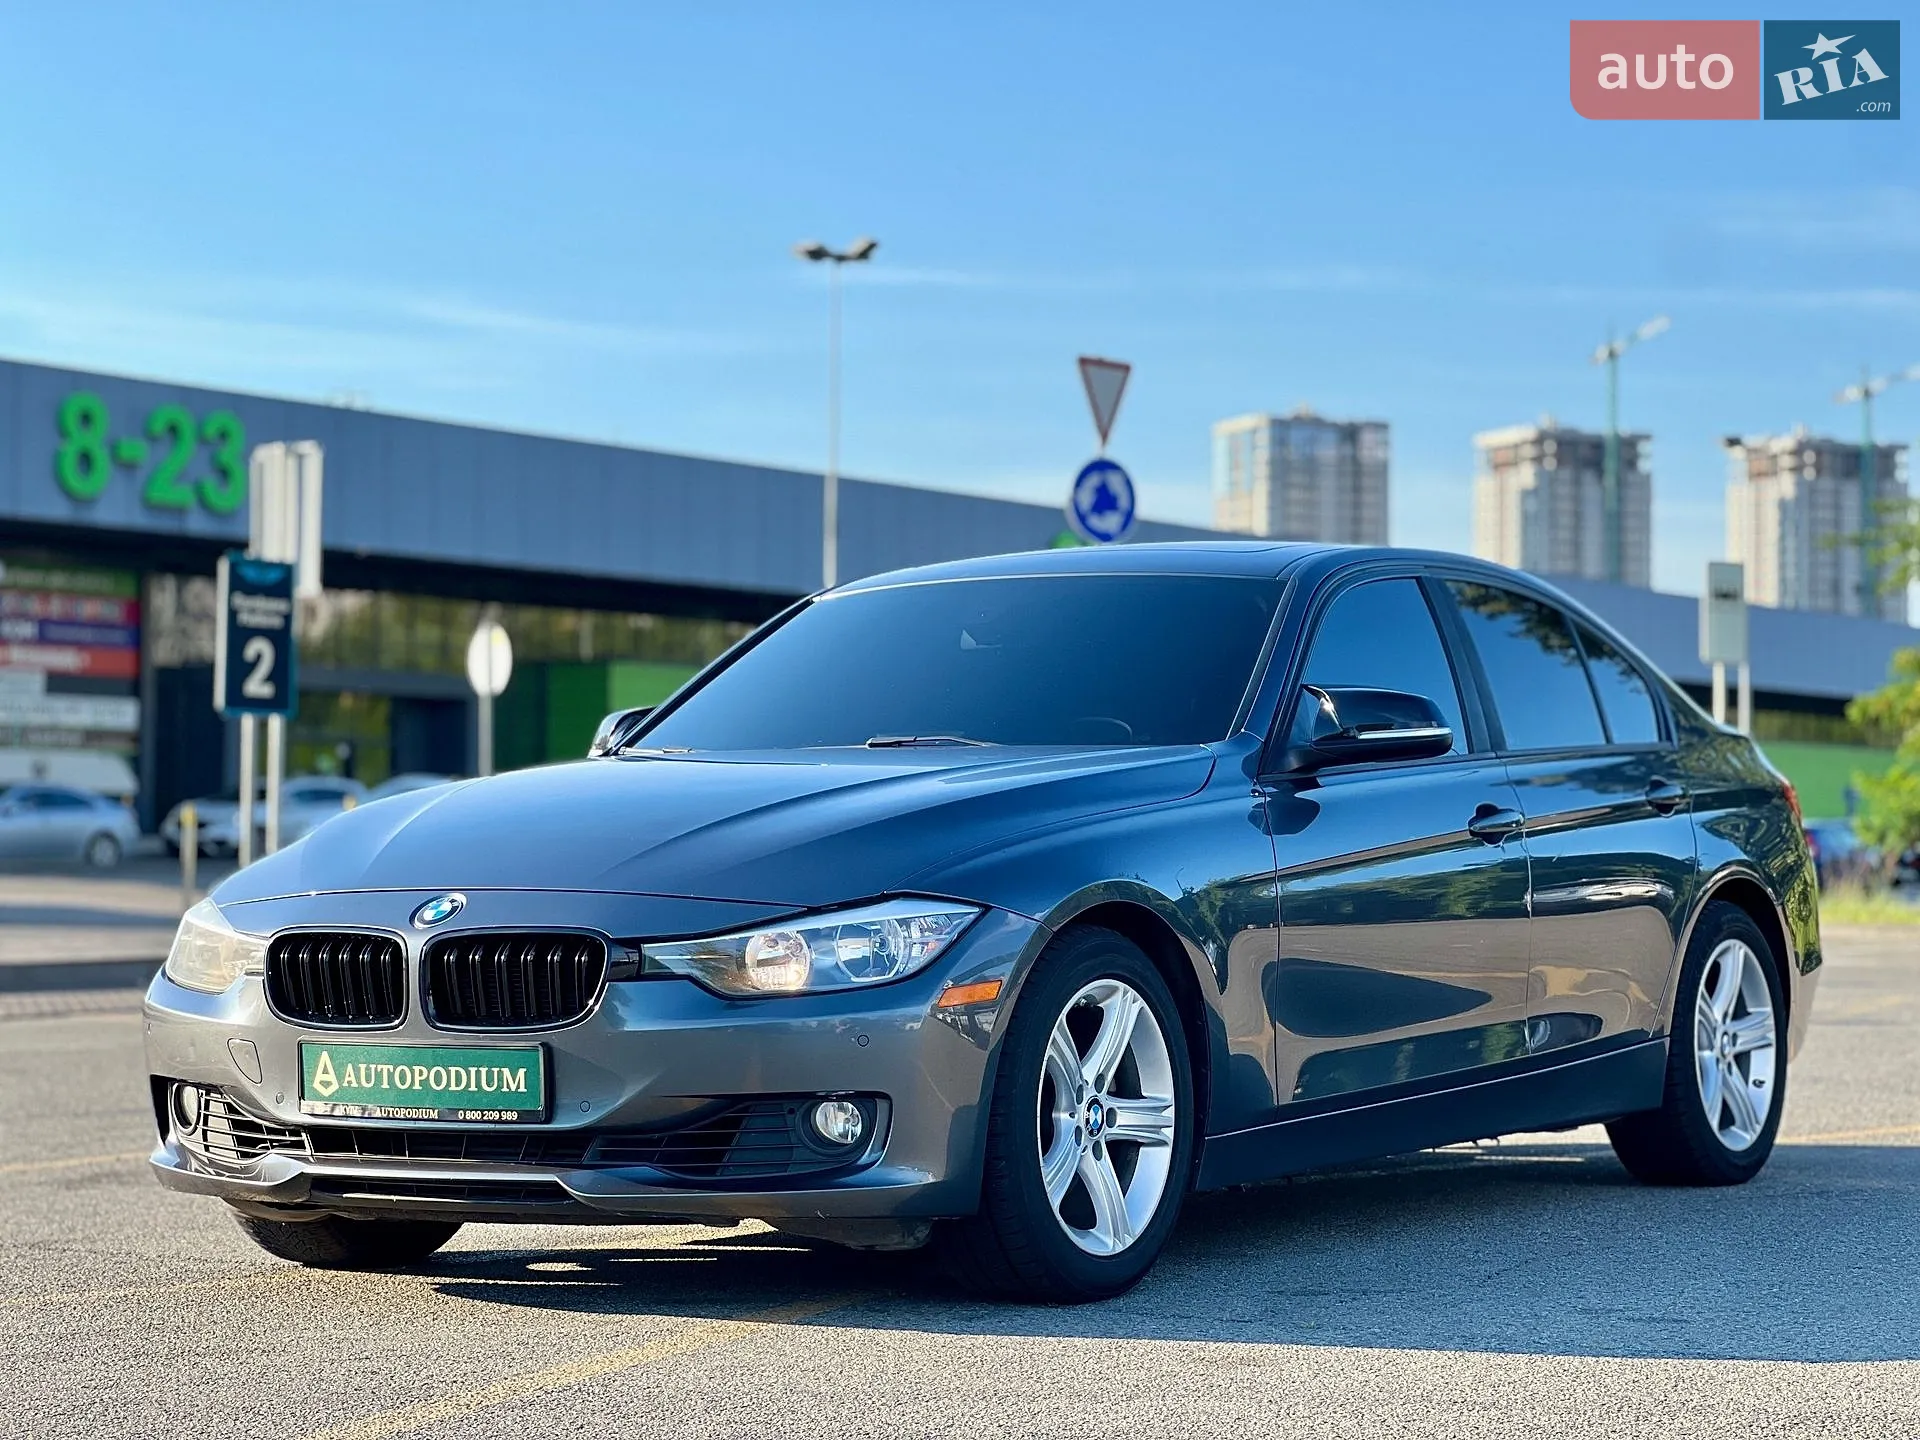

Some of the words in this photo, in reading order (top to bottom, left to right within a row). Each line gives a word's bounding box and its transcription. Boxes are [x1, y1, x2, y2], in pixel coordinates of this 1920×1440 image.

[56, 391, 248, 515] 8-23
[242, 636, 276, 699] 2
[343, 1063, 527, 1093] AUTOPODIUM
[375, 1107, 439, 1119] AUTOPODIUM
[465, 1110, 482, 1120] 800
[483, 1110, 500, 1120] 209
[501, 1110, 518, 1120] 989
